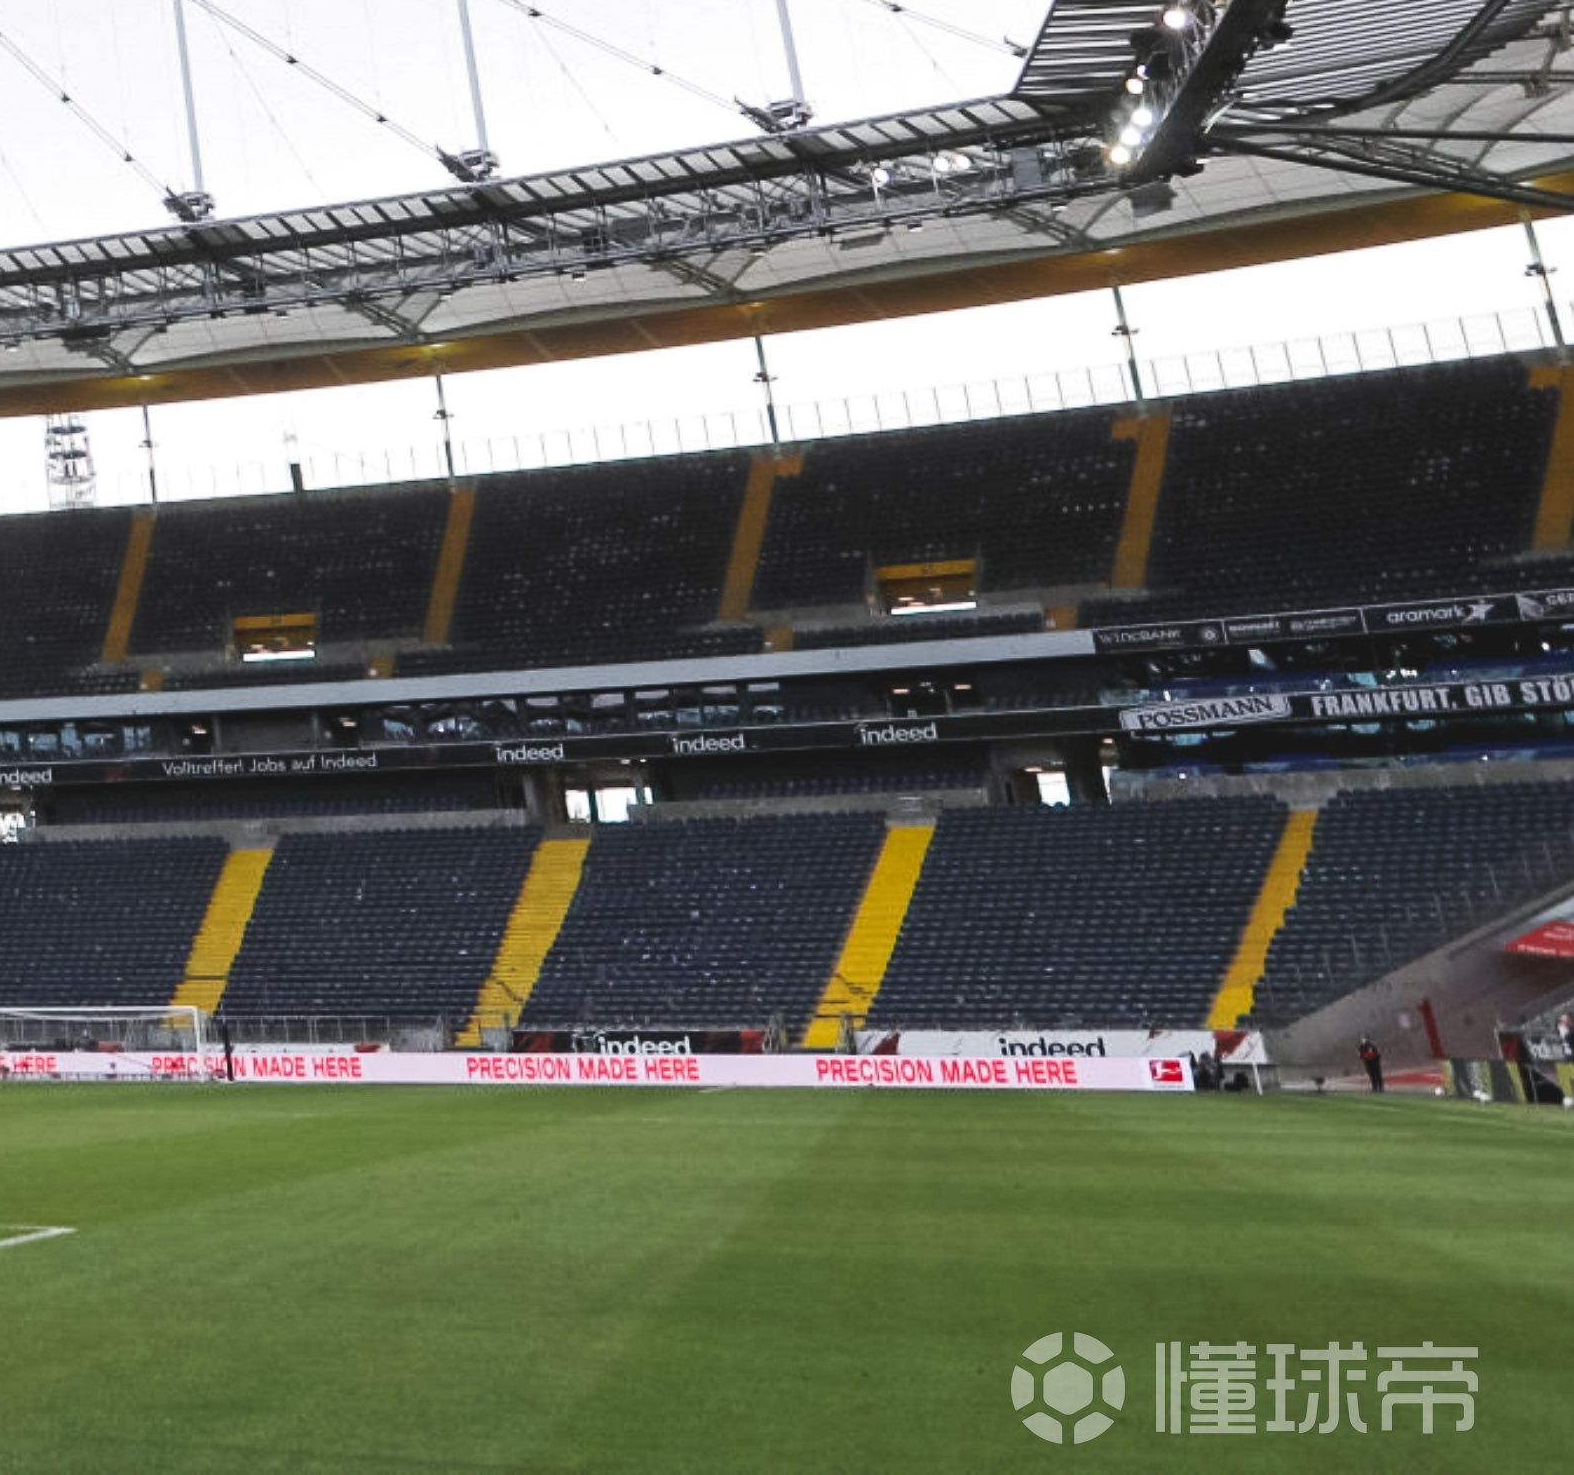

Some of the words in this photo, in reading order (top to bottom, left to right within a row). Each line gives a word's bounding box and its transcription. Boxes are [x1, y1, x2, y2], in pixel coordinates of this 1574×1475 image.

[1464, 683, 1512, 708] GIB
[1138, 695, 1272, 729] POSSMANN
[672, 733, 746, 755] indeed
[860, 721, 938, 746] indeed
[250, 756, 286, 774] Jobs
[292, 754, 316, 771] auf
[495, 741, 564, 764] indeed
[597, 1035, 691, 1055] indeed
[999, 1036, 1106, 1057] indeed
[252, 1055, 305, 1078] MADE
[312, 1056, 362, 1078] HERE
[466, 1056, 571, 1080] PRECISION
[578, 1057, 638, 1080] MADE
[645, 1057, 699, 1081] HERE
[815, 1058, 933, 1084] PRECISION
[940, 1059, 1007, 1084] MADE
[1015, 1060, 1078, 1085] HERE
